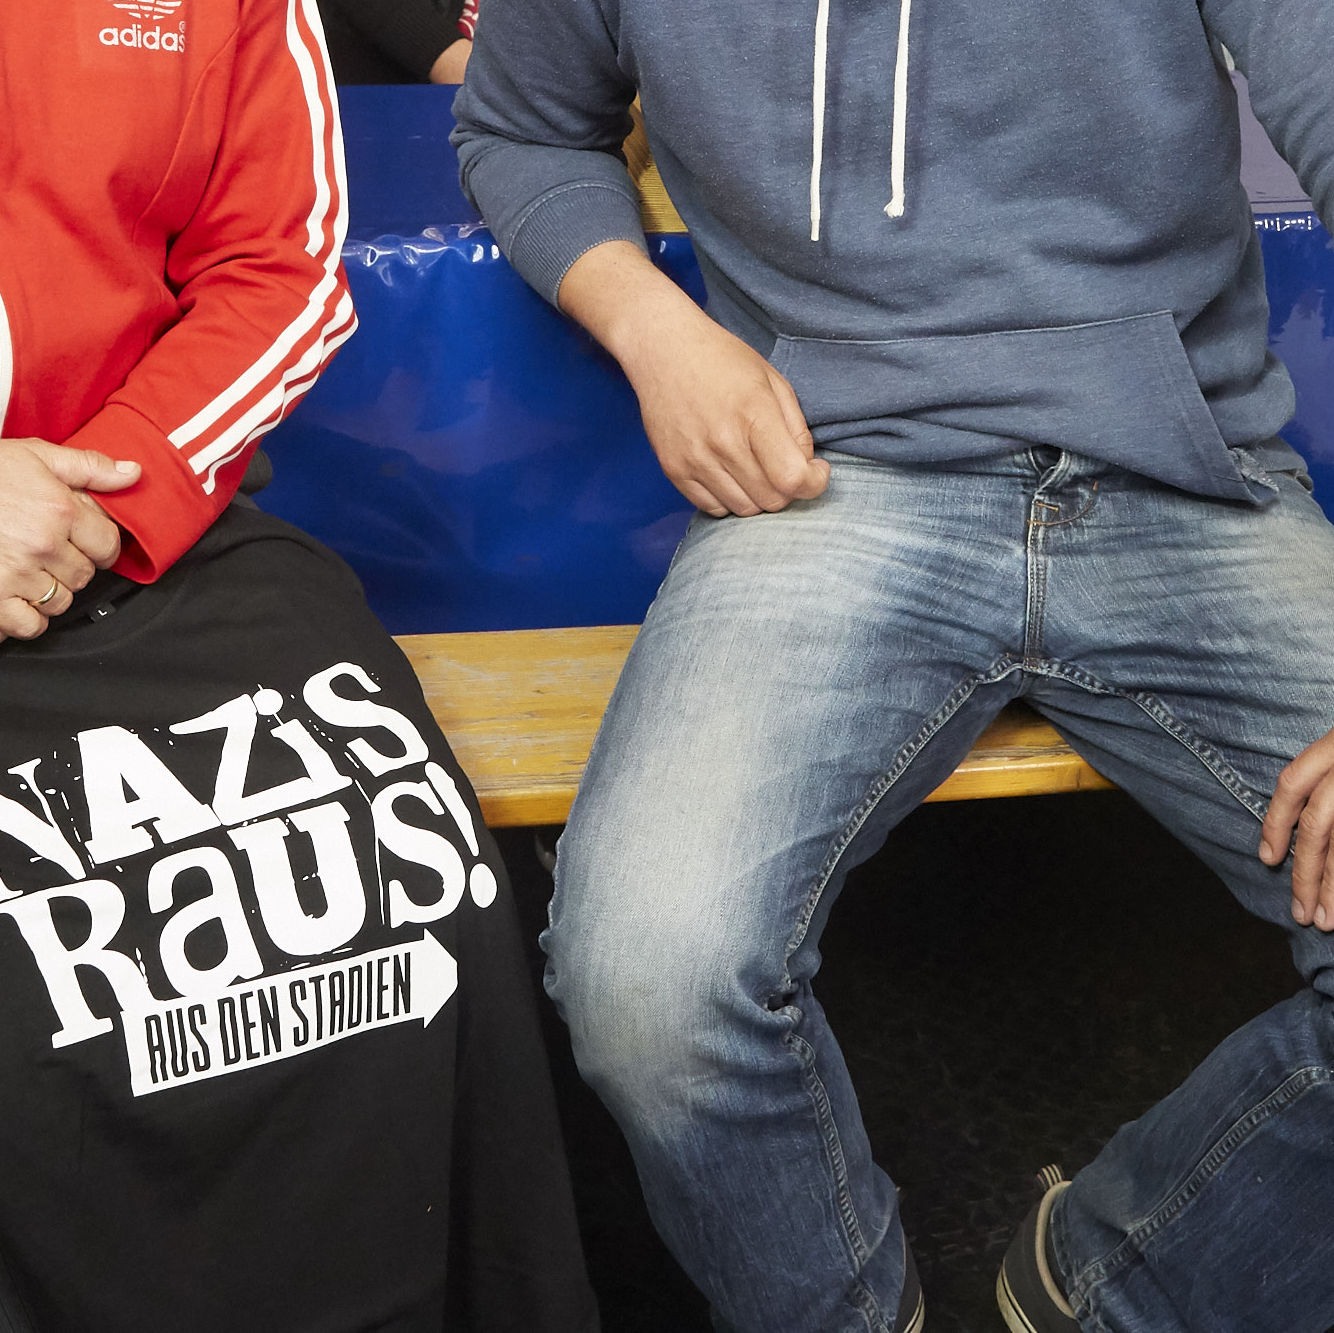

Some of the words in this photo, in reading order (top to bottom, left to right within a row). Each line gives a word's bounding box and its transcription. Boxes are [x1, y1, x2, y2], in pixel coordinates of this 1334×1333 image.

[99, 23, 186, 53] adidas
[145, 1006, 212, 1086] AUS
[216, 985, 283, 1068] DEN
[290, 951, 415, 1047] STADIEN
